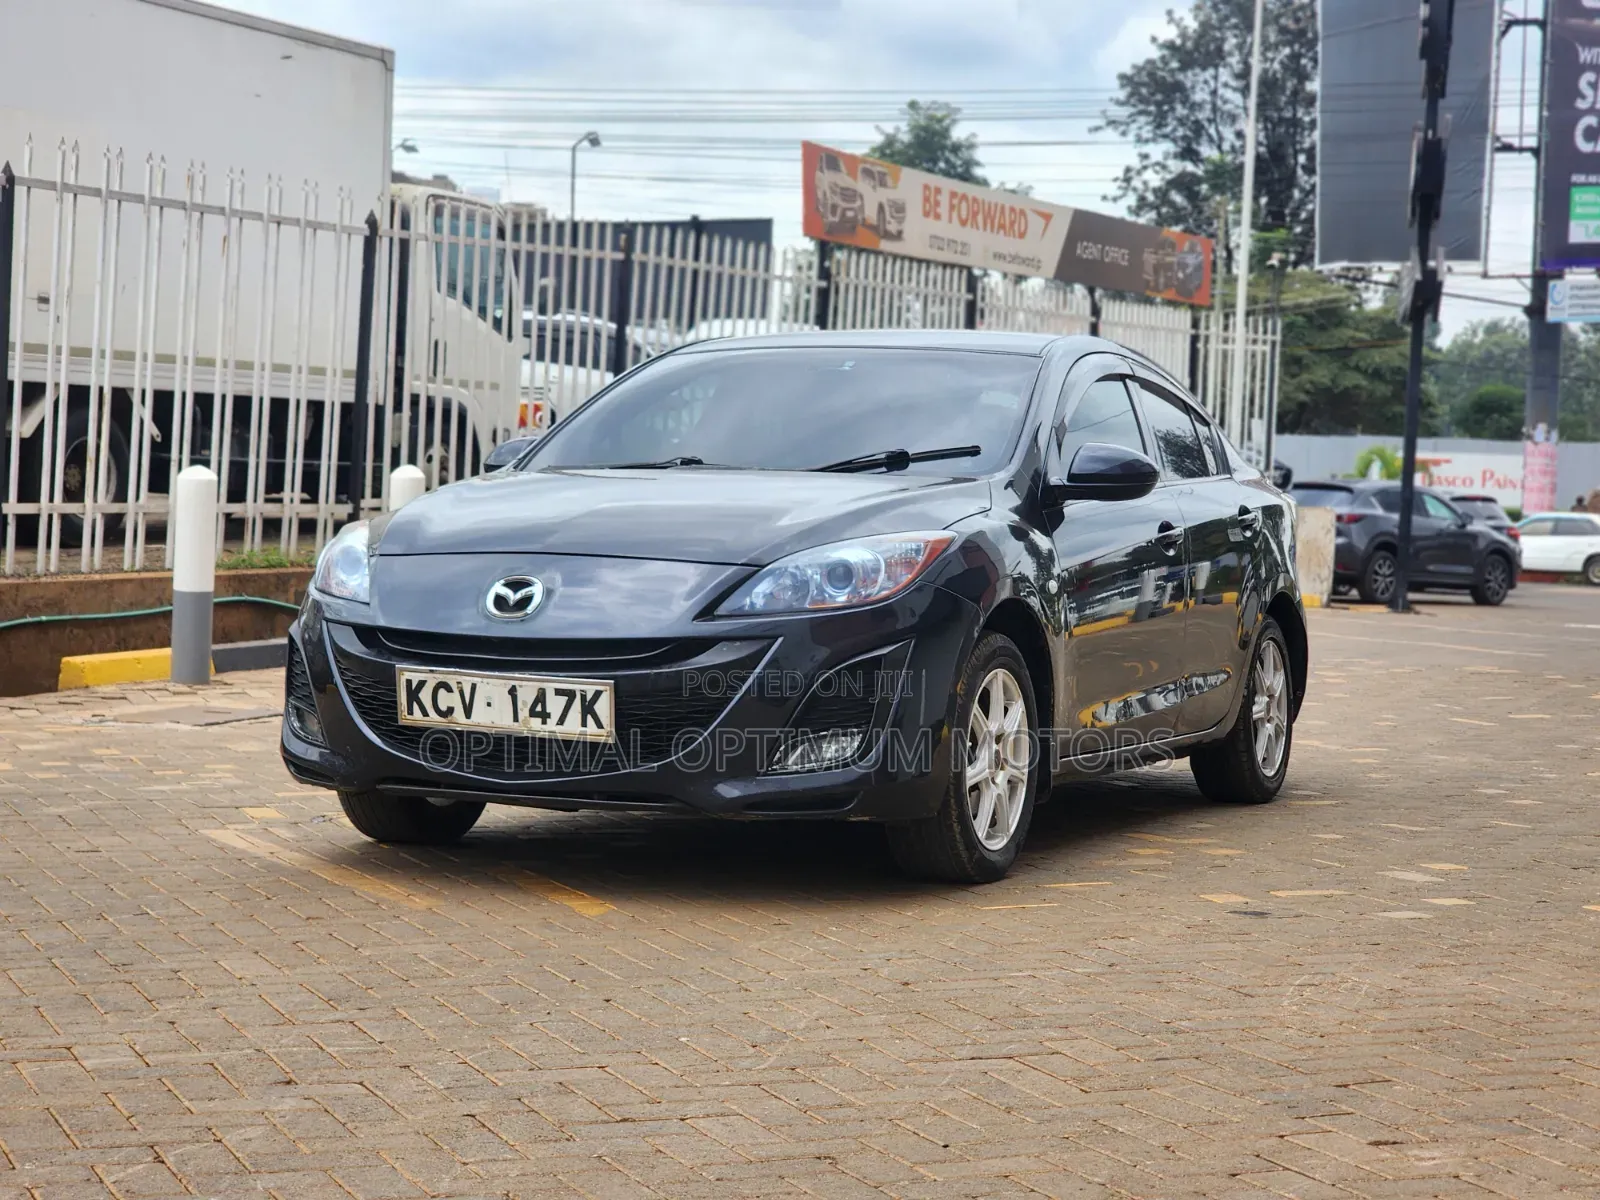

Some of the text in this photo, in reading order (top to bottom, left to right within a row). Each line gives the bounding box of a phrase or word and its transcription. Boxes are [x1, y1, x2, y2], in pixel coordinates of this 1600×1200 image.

[922, 183, 1029, 240] BE FORWARD
[1076, 240, 1130, 267] AGENT OFFICE
[405, 678, 606, 730] KCV 147K
